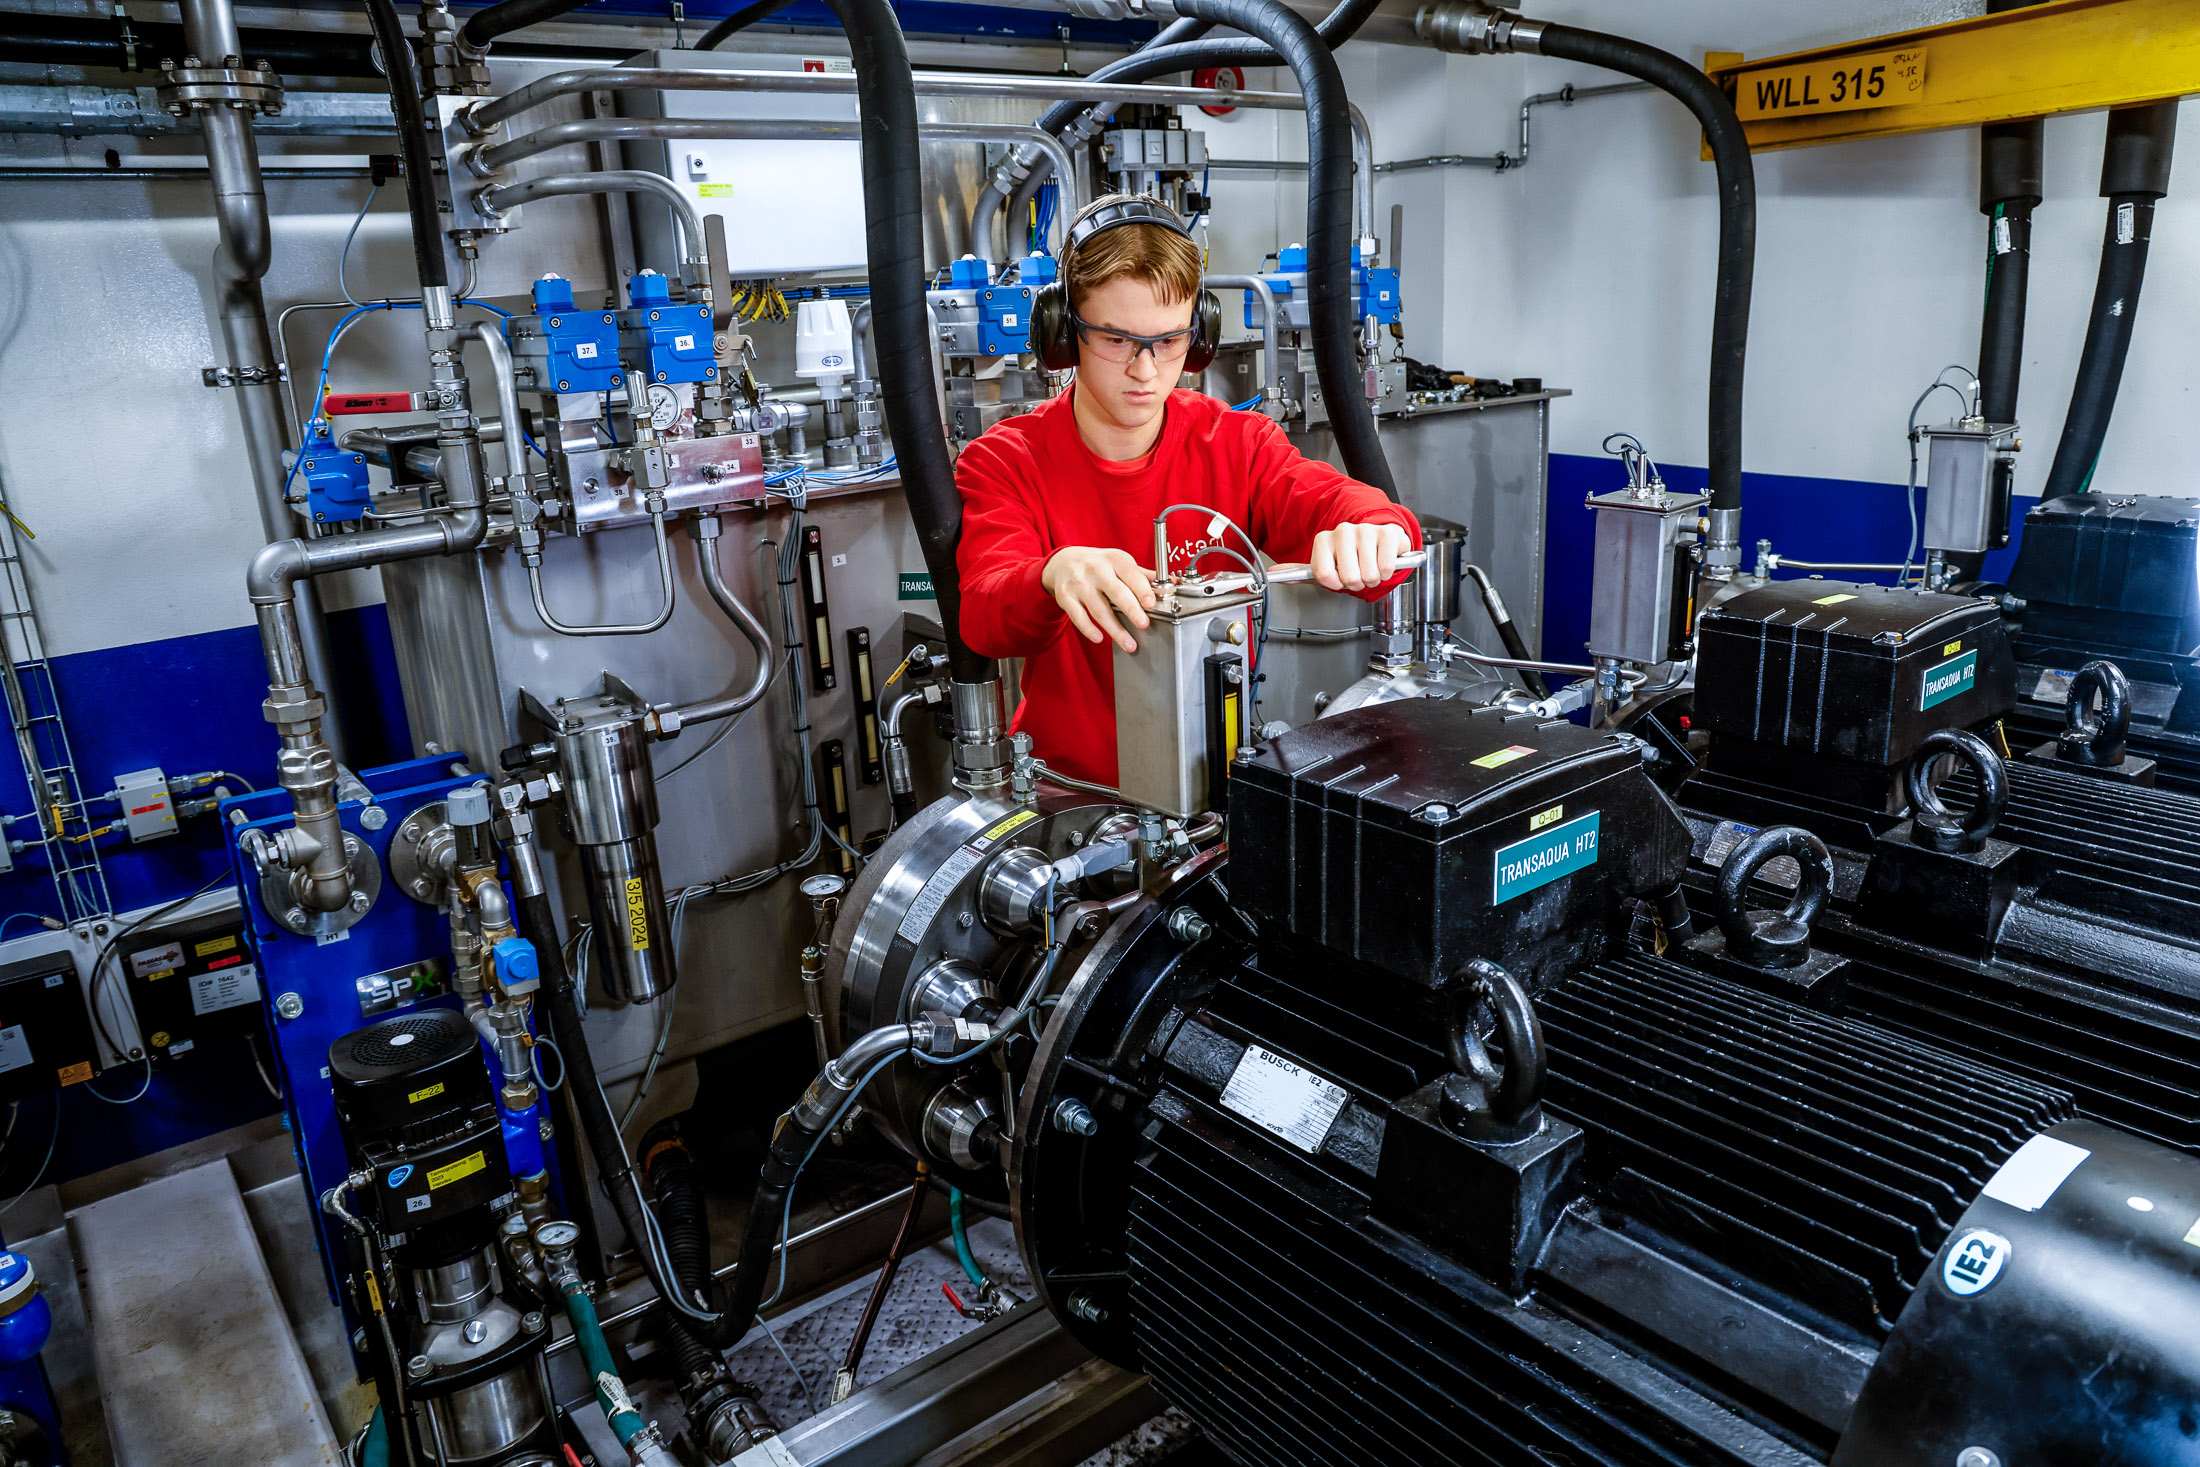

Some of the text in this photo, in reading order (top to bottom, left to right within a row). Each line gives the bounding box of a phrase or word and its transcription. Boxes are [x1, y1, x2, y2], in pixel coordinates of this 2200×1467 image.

[1756, 65, 1886, 111] WLL 315
[582, 347, 593, 355] 37.
[726, 463, 737, 471] 34.
[900, 581, 935, 592] TRANSA
[1926, 663, 1976, 697] TRANSAQUA HT2
[605, 736, 617, 744] 39.
[1538, 809, 1559, 825] Q-01
[1500, 830, 1596, 885] TRANSAQUA HT2
[626, 881, 648, 944] 3/5 2024
[326, 932, 339, 941] H1
[371, 970, 436, 1004] SPX
[1260, 1050, 1301, 1076] BUSCK
[1308, 1075, 1322, 1087] IE2
[416, 1085, 441, 1100] F-22
[412, 1199, 426, 1208] 26.
[1950, 1238, 1997, 1285] IE2
